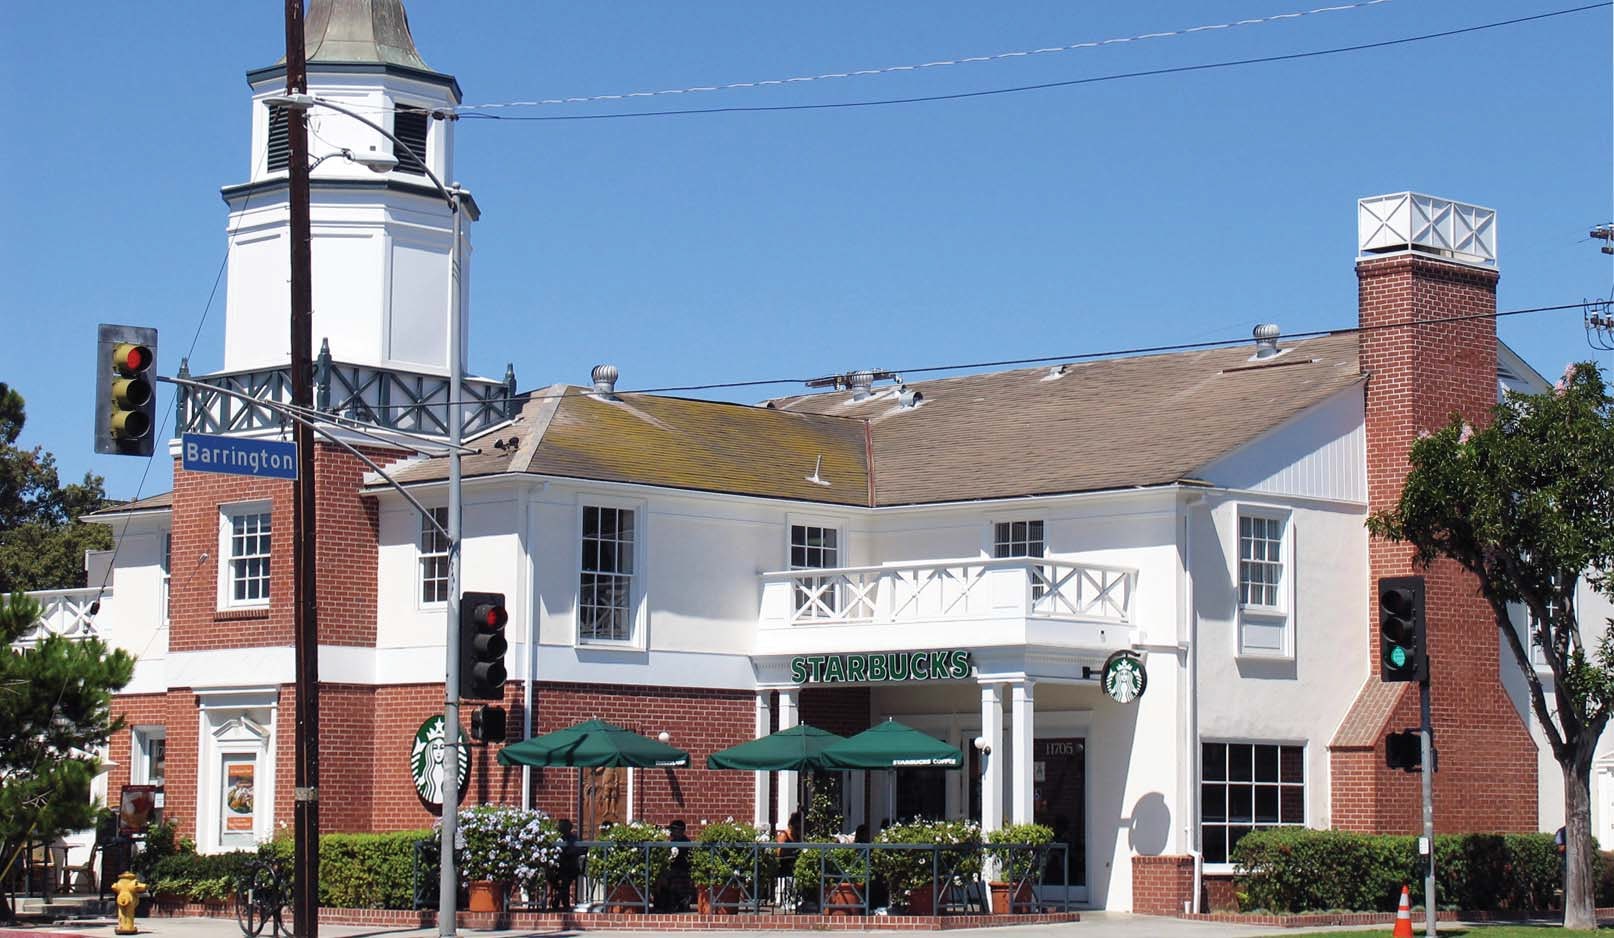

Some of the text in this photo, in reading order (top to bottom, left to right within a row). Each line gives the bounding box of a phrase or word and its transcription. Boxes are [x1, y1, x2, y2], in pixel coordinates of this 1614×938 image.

[187, 442, 293, 473] Barrington
[790, 650, 969, 683] STARBUCKS
[1046, 742, 1073, 755] 11705
